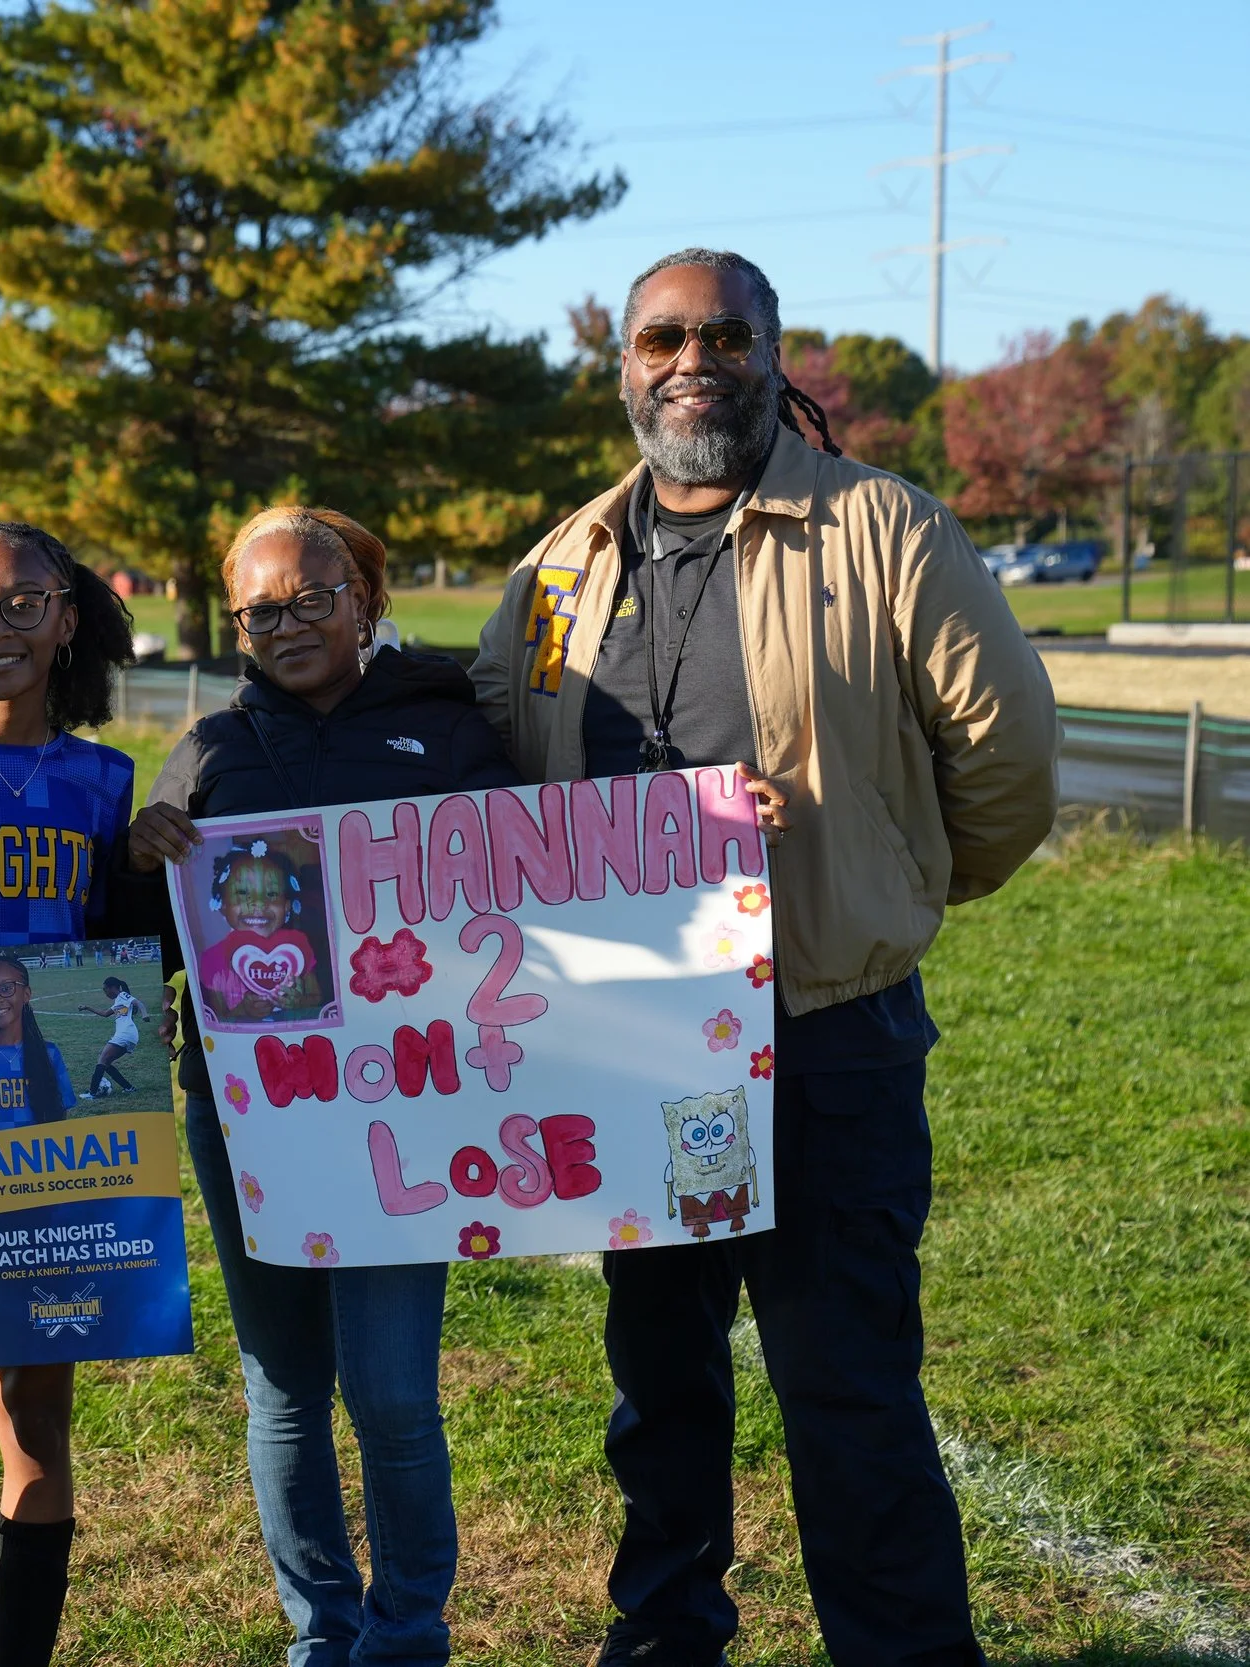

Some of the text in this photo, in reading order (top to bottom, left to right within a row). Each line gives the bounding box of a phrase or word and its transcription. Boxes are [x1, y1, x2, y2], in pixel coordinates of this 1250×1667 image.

[386, 738, 412, 748] NORTH
[338, 767, 765, 934] HANNAH
[9, 1181, 45, 1195] GIRLS
[48, 1177, 98, 1192] SOCCER
[100, 1174, 134, 1188] 2026
[35, 1222, 117, 1245] KNIGHTS
[52, 1244, 91, 1263] HAS
[94, 1238, 154, 1260] ENDED
[1, 1270, 27, 1281] ONCE
[28, 1269, 35, 1278] A
[75, 1262, 114, 1274] ALWAYS
[115, 1261, 123, 1270] A
[31, 1298, 100, 1319] FOUNDATION
[40, 1315, 93, 1325] ACADEMIES
